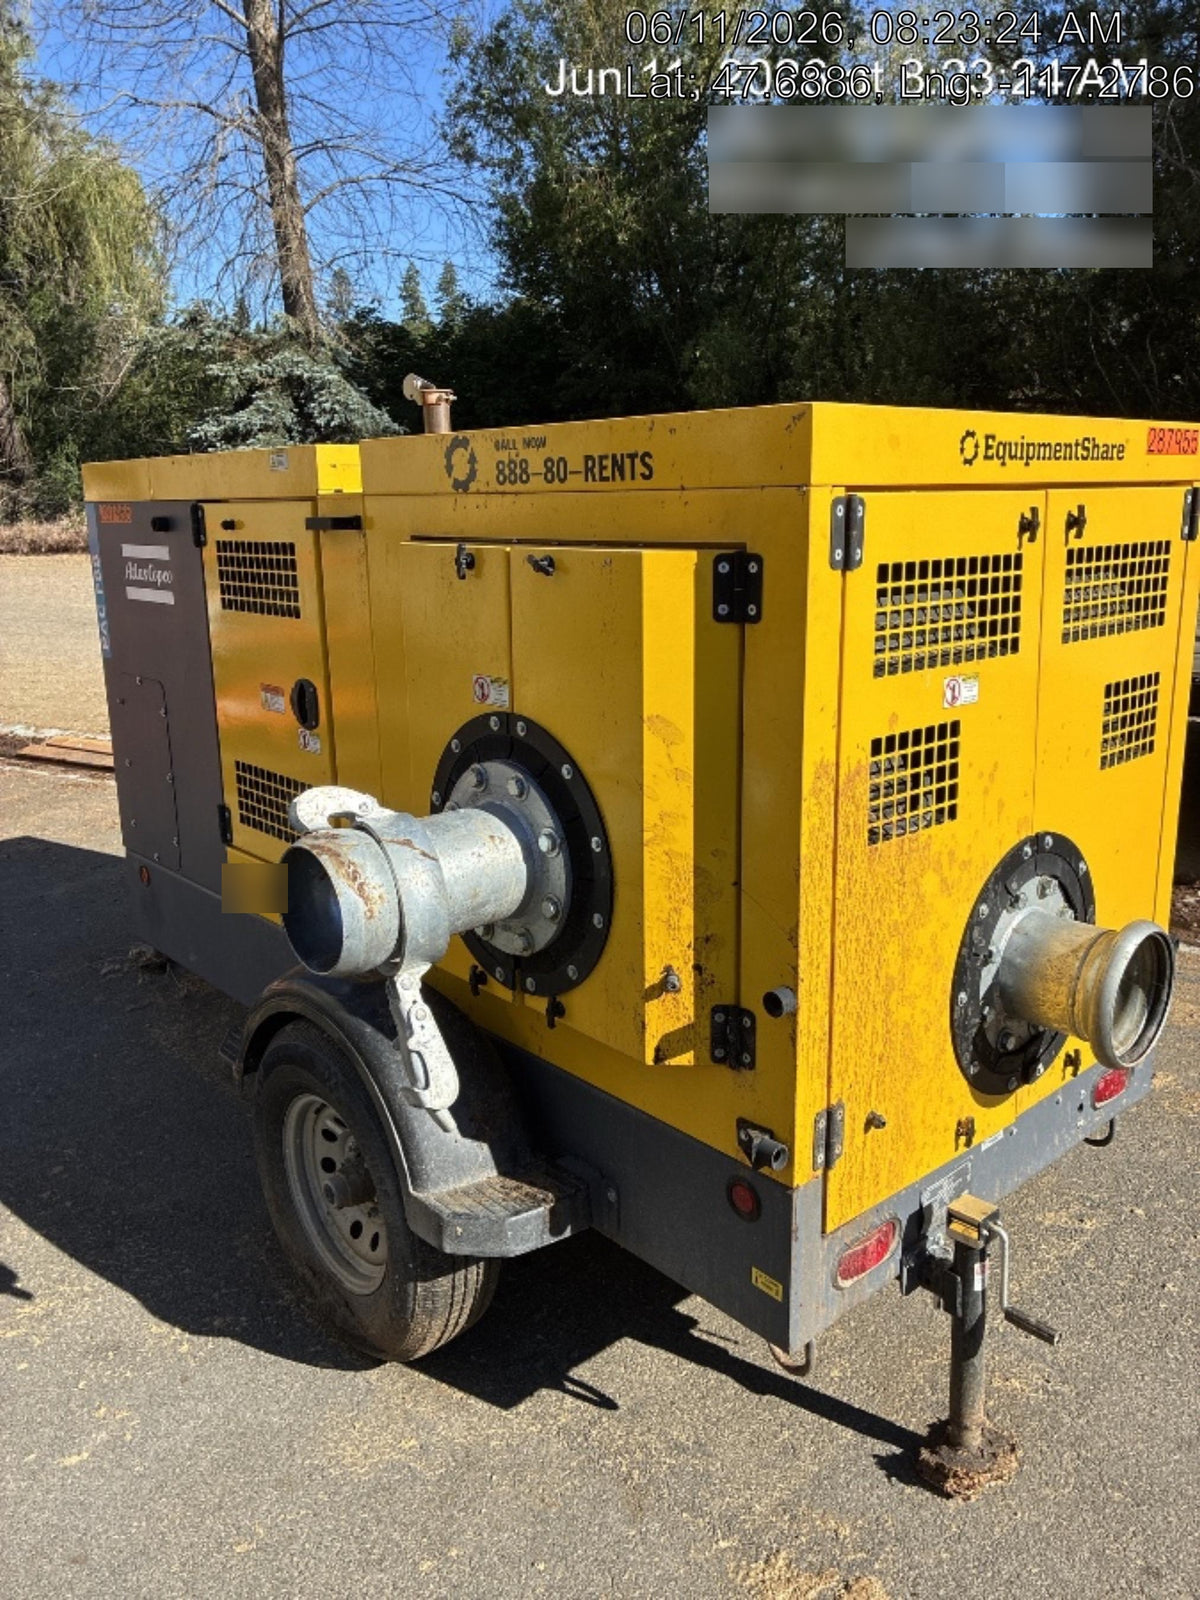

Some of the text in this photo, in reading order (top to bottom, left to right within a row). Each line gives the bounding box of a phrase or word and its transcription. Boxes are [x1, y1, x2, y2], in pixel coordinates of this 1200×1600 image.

[522, 435, 547, 450] NOW
[982, 433, 1125, 467] EquipmentShare
[495, 451, 654, 486] 888-80-RENTS
